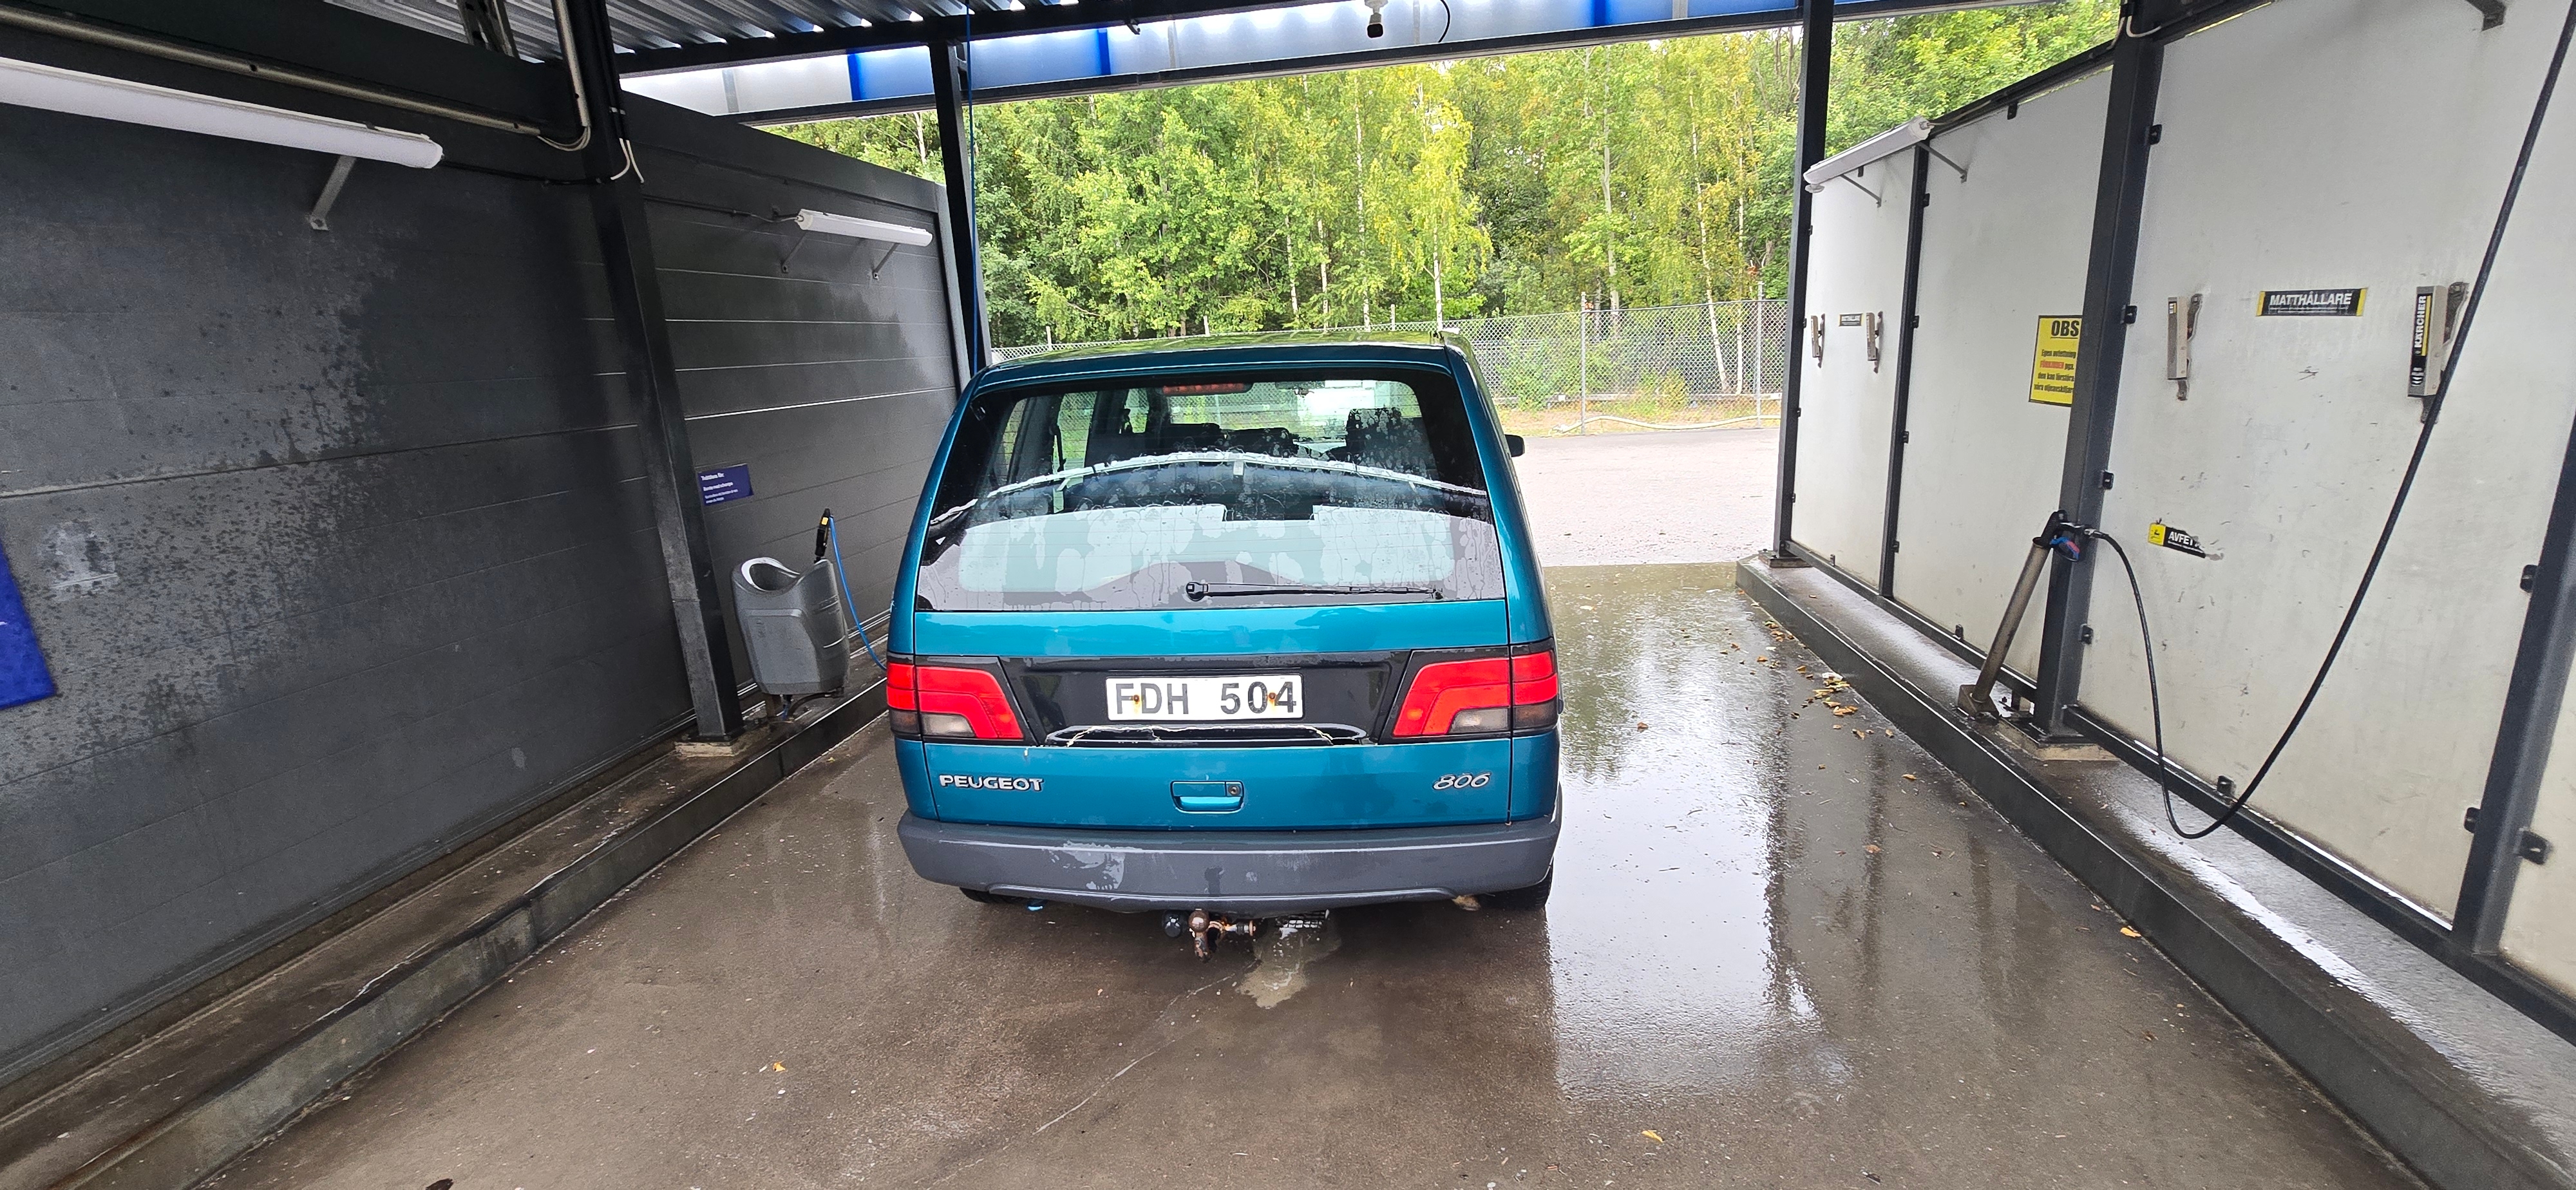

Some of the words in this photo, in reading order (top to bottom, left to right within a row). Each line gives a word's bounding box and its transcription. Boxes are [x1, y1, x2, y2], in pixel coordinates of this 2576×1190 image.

[2269, 291, 2353, 305] MATTHÅLLARE
[2051, 321, 2079, 336] OBS
[1115, 683, 1189, 715] FDH
[1220, 681, 1296, 714] 504
[939, 775, 1043, 791] PEUGEOT
[1434, 773, 1490, 790] 806
